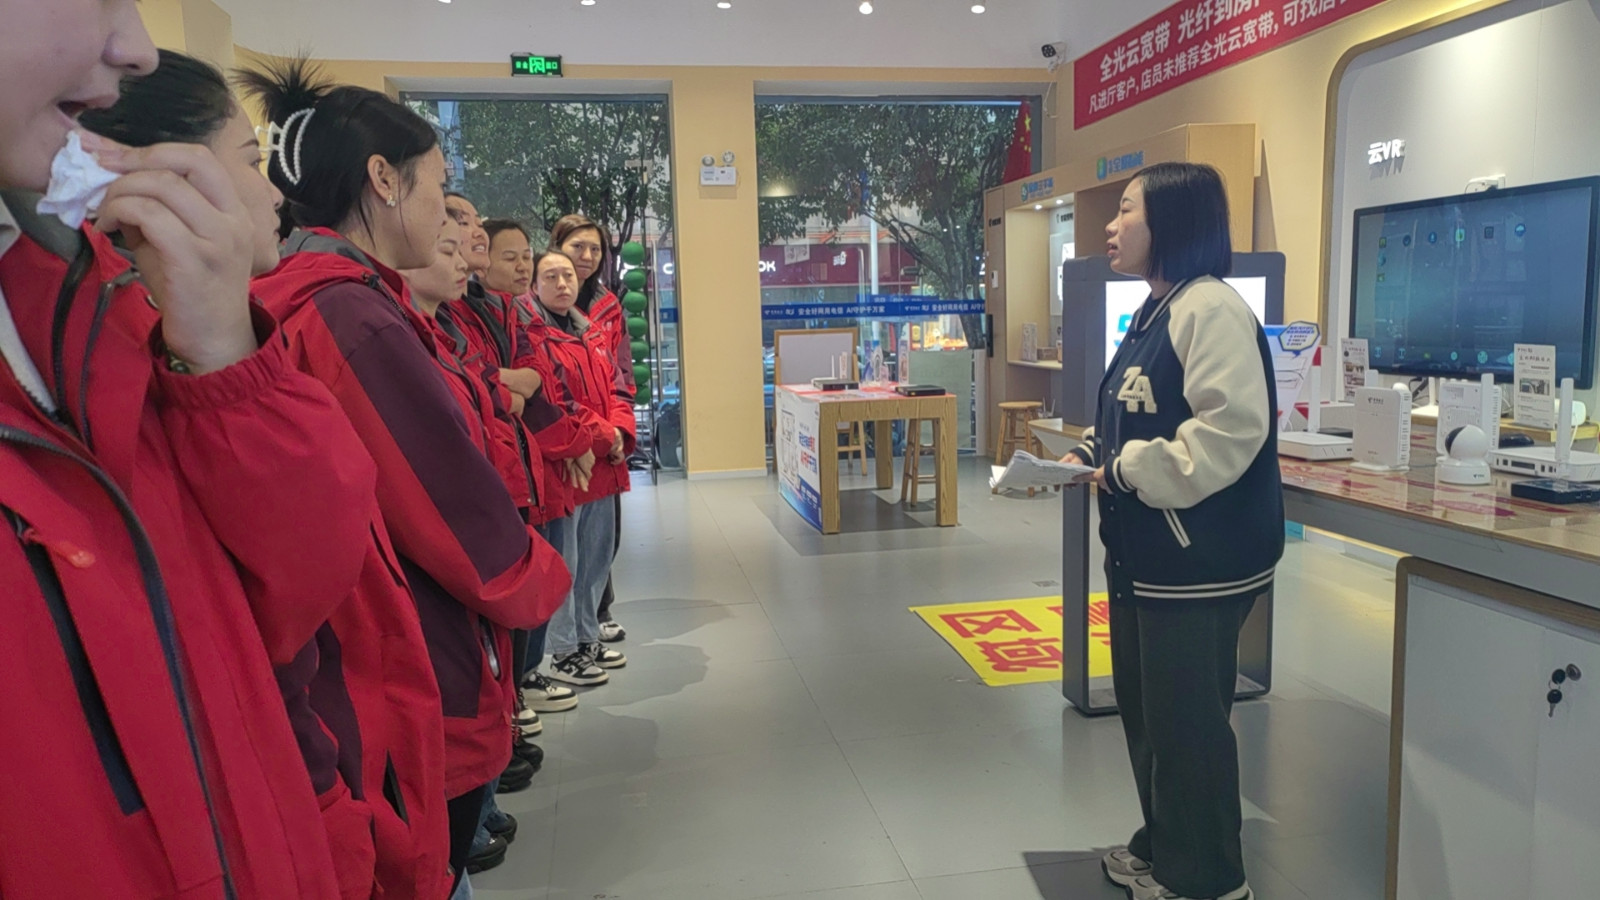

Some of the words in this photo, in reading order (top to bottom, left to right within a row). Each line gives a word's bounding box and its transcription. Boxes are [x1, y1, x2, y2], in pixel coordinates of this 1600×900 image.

[1099, 20, 1171, 83] 全光云宽带
[1367, 138, 1402, 165] 云VR
